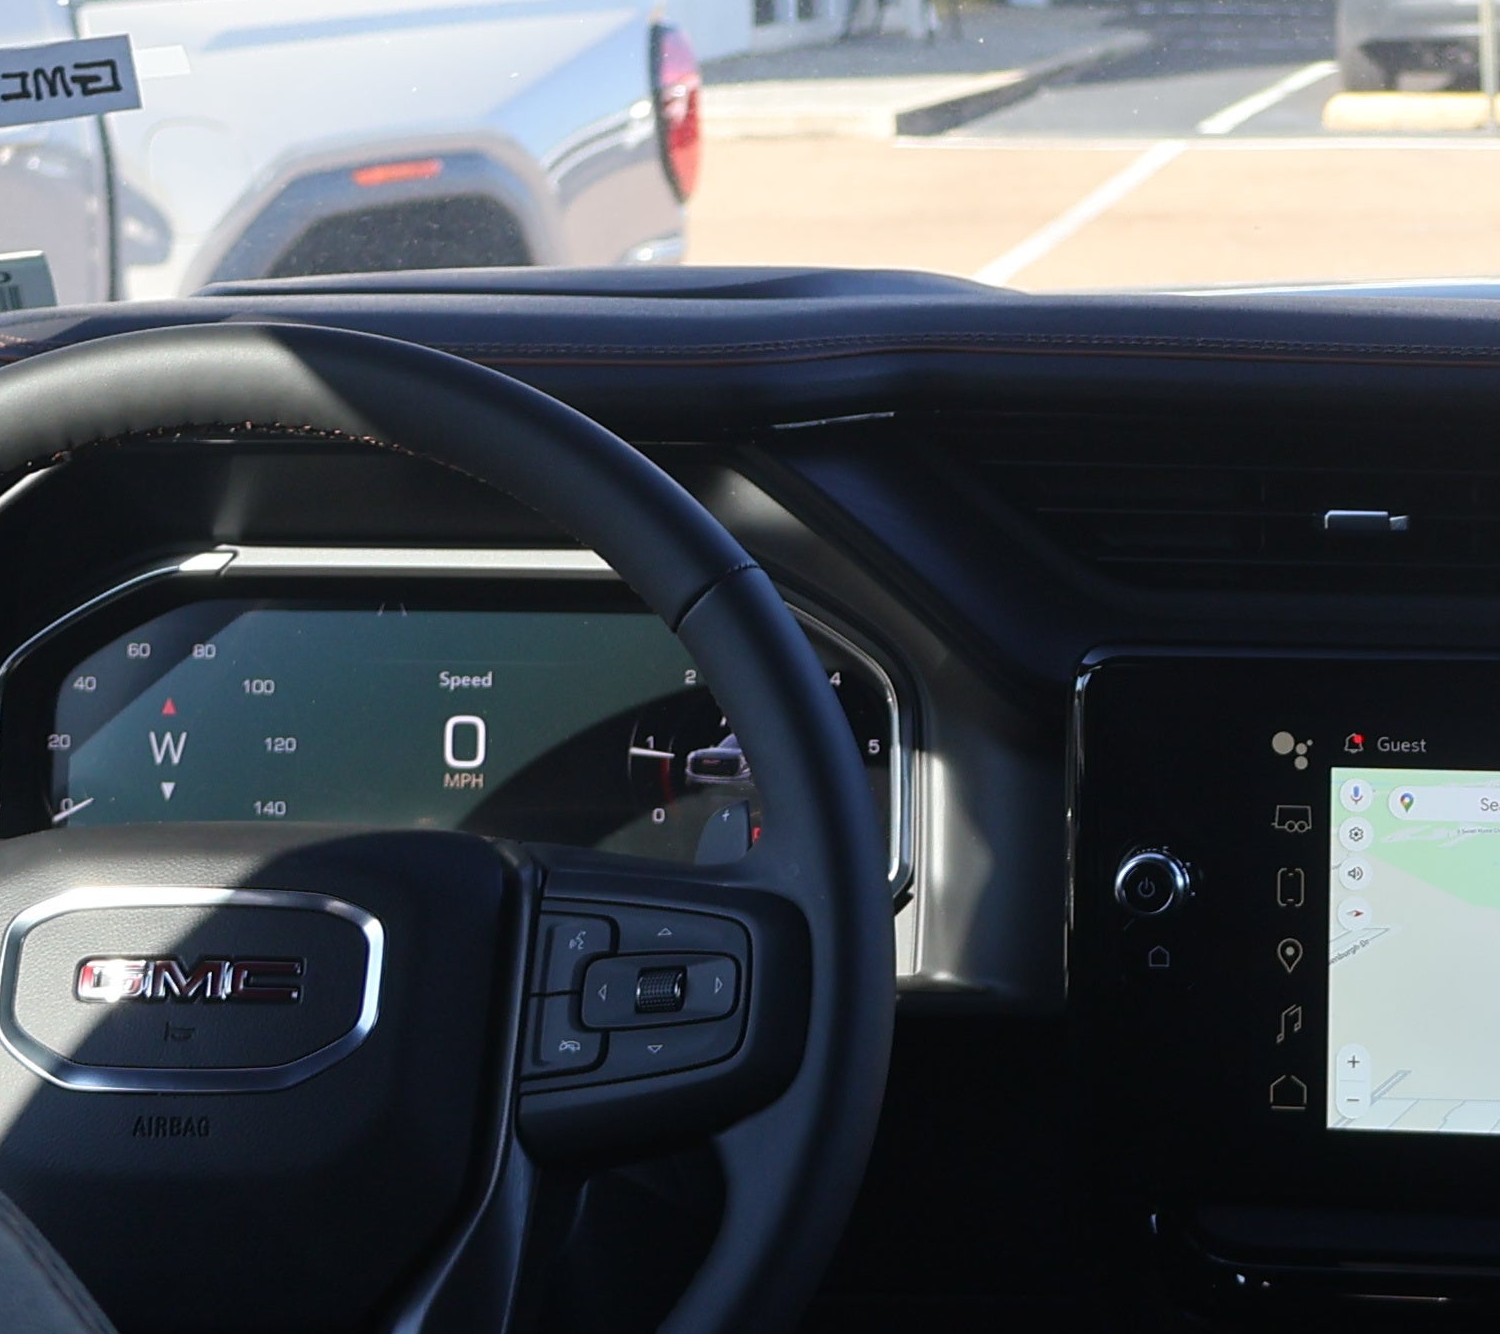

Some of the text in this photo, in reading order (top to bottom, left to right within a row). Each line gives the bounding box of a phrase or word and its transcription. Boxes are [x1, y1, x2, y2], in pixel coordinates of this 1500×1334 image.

[126, 642, 151, 659] 60
[192, 643, 217, 659] 80
[72, 675, 97, 691] 40
[438, 670, 493, 692] Speed
[684, 669, 697, 685] 2
[829, 671, 842, 687] 4
[241, 678, 276, 695] 100
[47, 733, 72, 749] 20
[148, 730, 188, 765] W
[263, 737, 298, 753] 120
[443, 714, 487, 769] 0
[868, 738, 880, 754] 5
[1376, 735, 1428, 753] Guest
[443, 772, 484, 789] MPH
[252, 800, 287, 816] 140
[651, 807, 666, 823] 0
[78, 957, 304, 1003] GMC
[132, 1114, 210, 1139] AIRBAG
